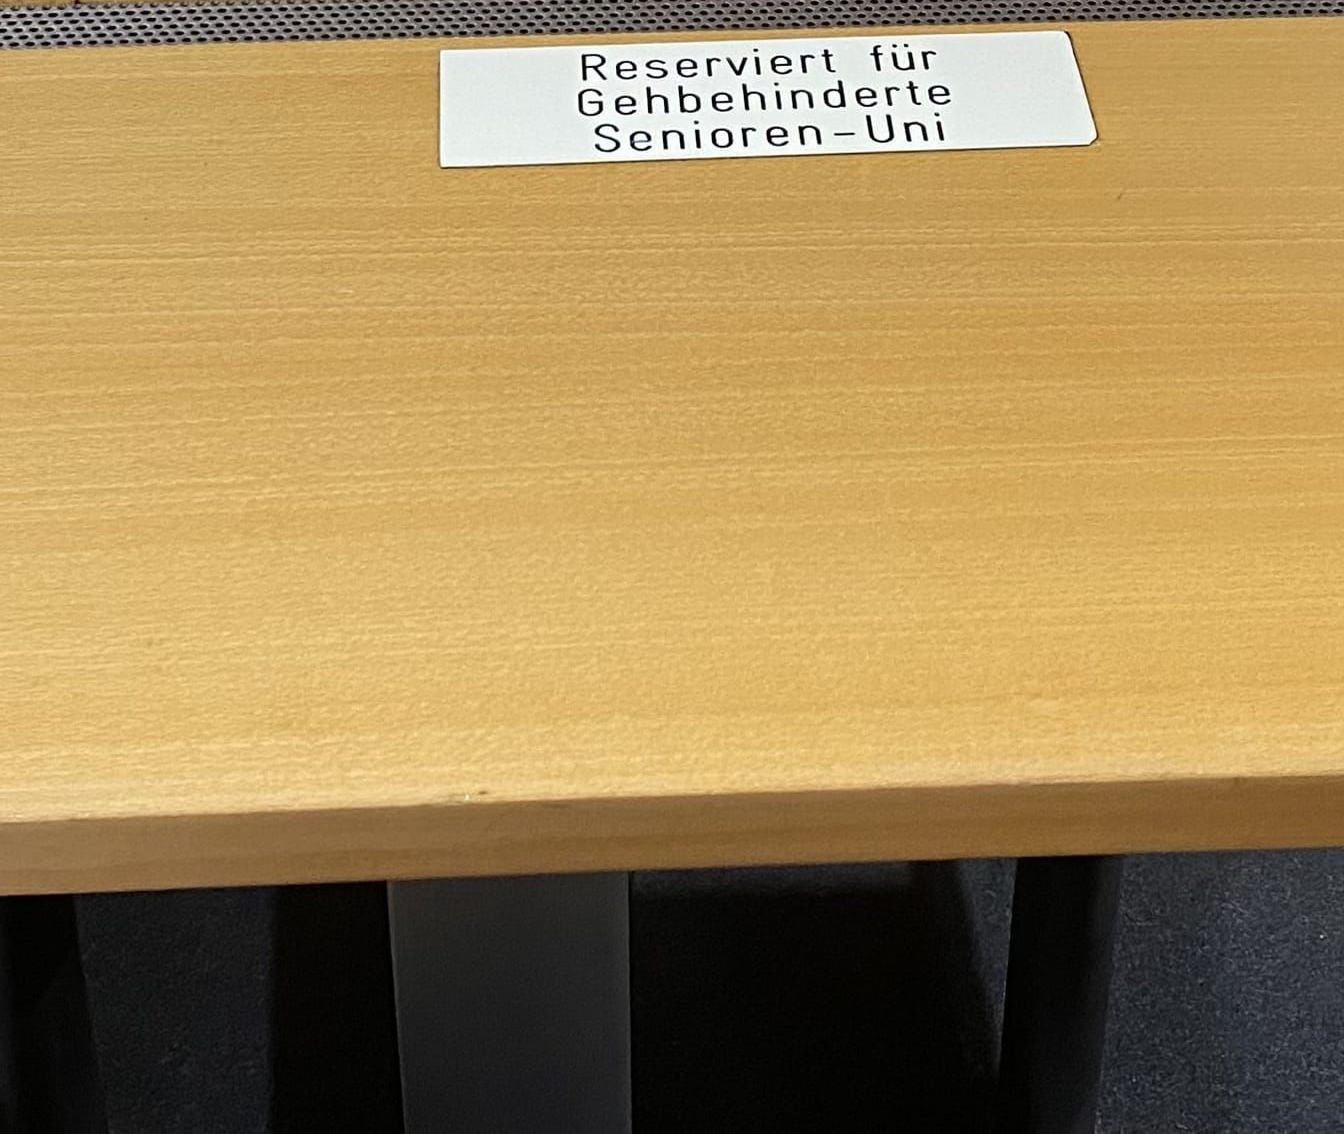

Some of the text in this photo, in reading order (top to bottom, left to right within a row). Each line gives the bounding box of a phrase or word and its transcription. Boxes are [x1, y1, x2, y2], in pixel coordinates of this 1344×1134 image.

[580, 44, 937, 81] Reserviert für
[577, 80, 951, 117] Gehbehinderte
[594, 114, 945, 153] Senioren-Uni
